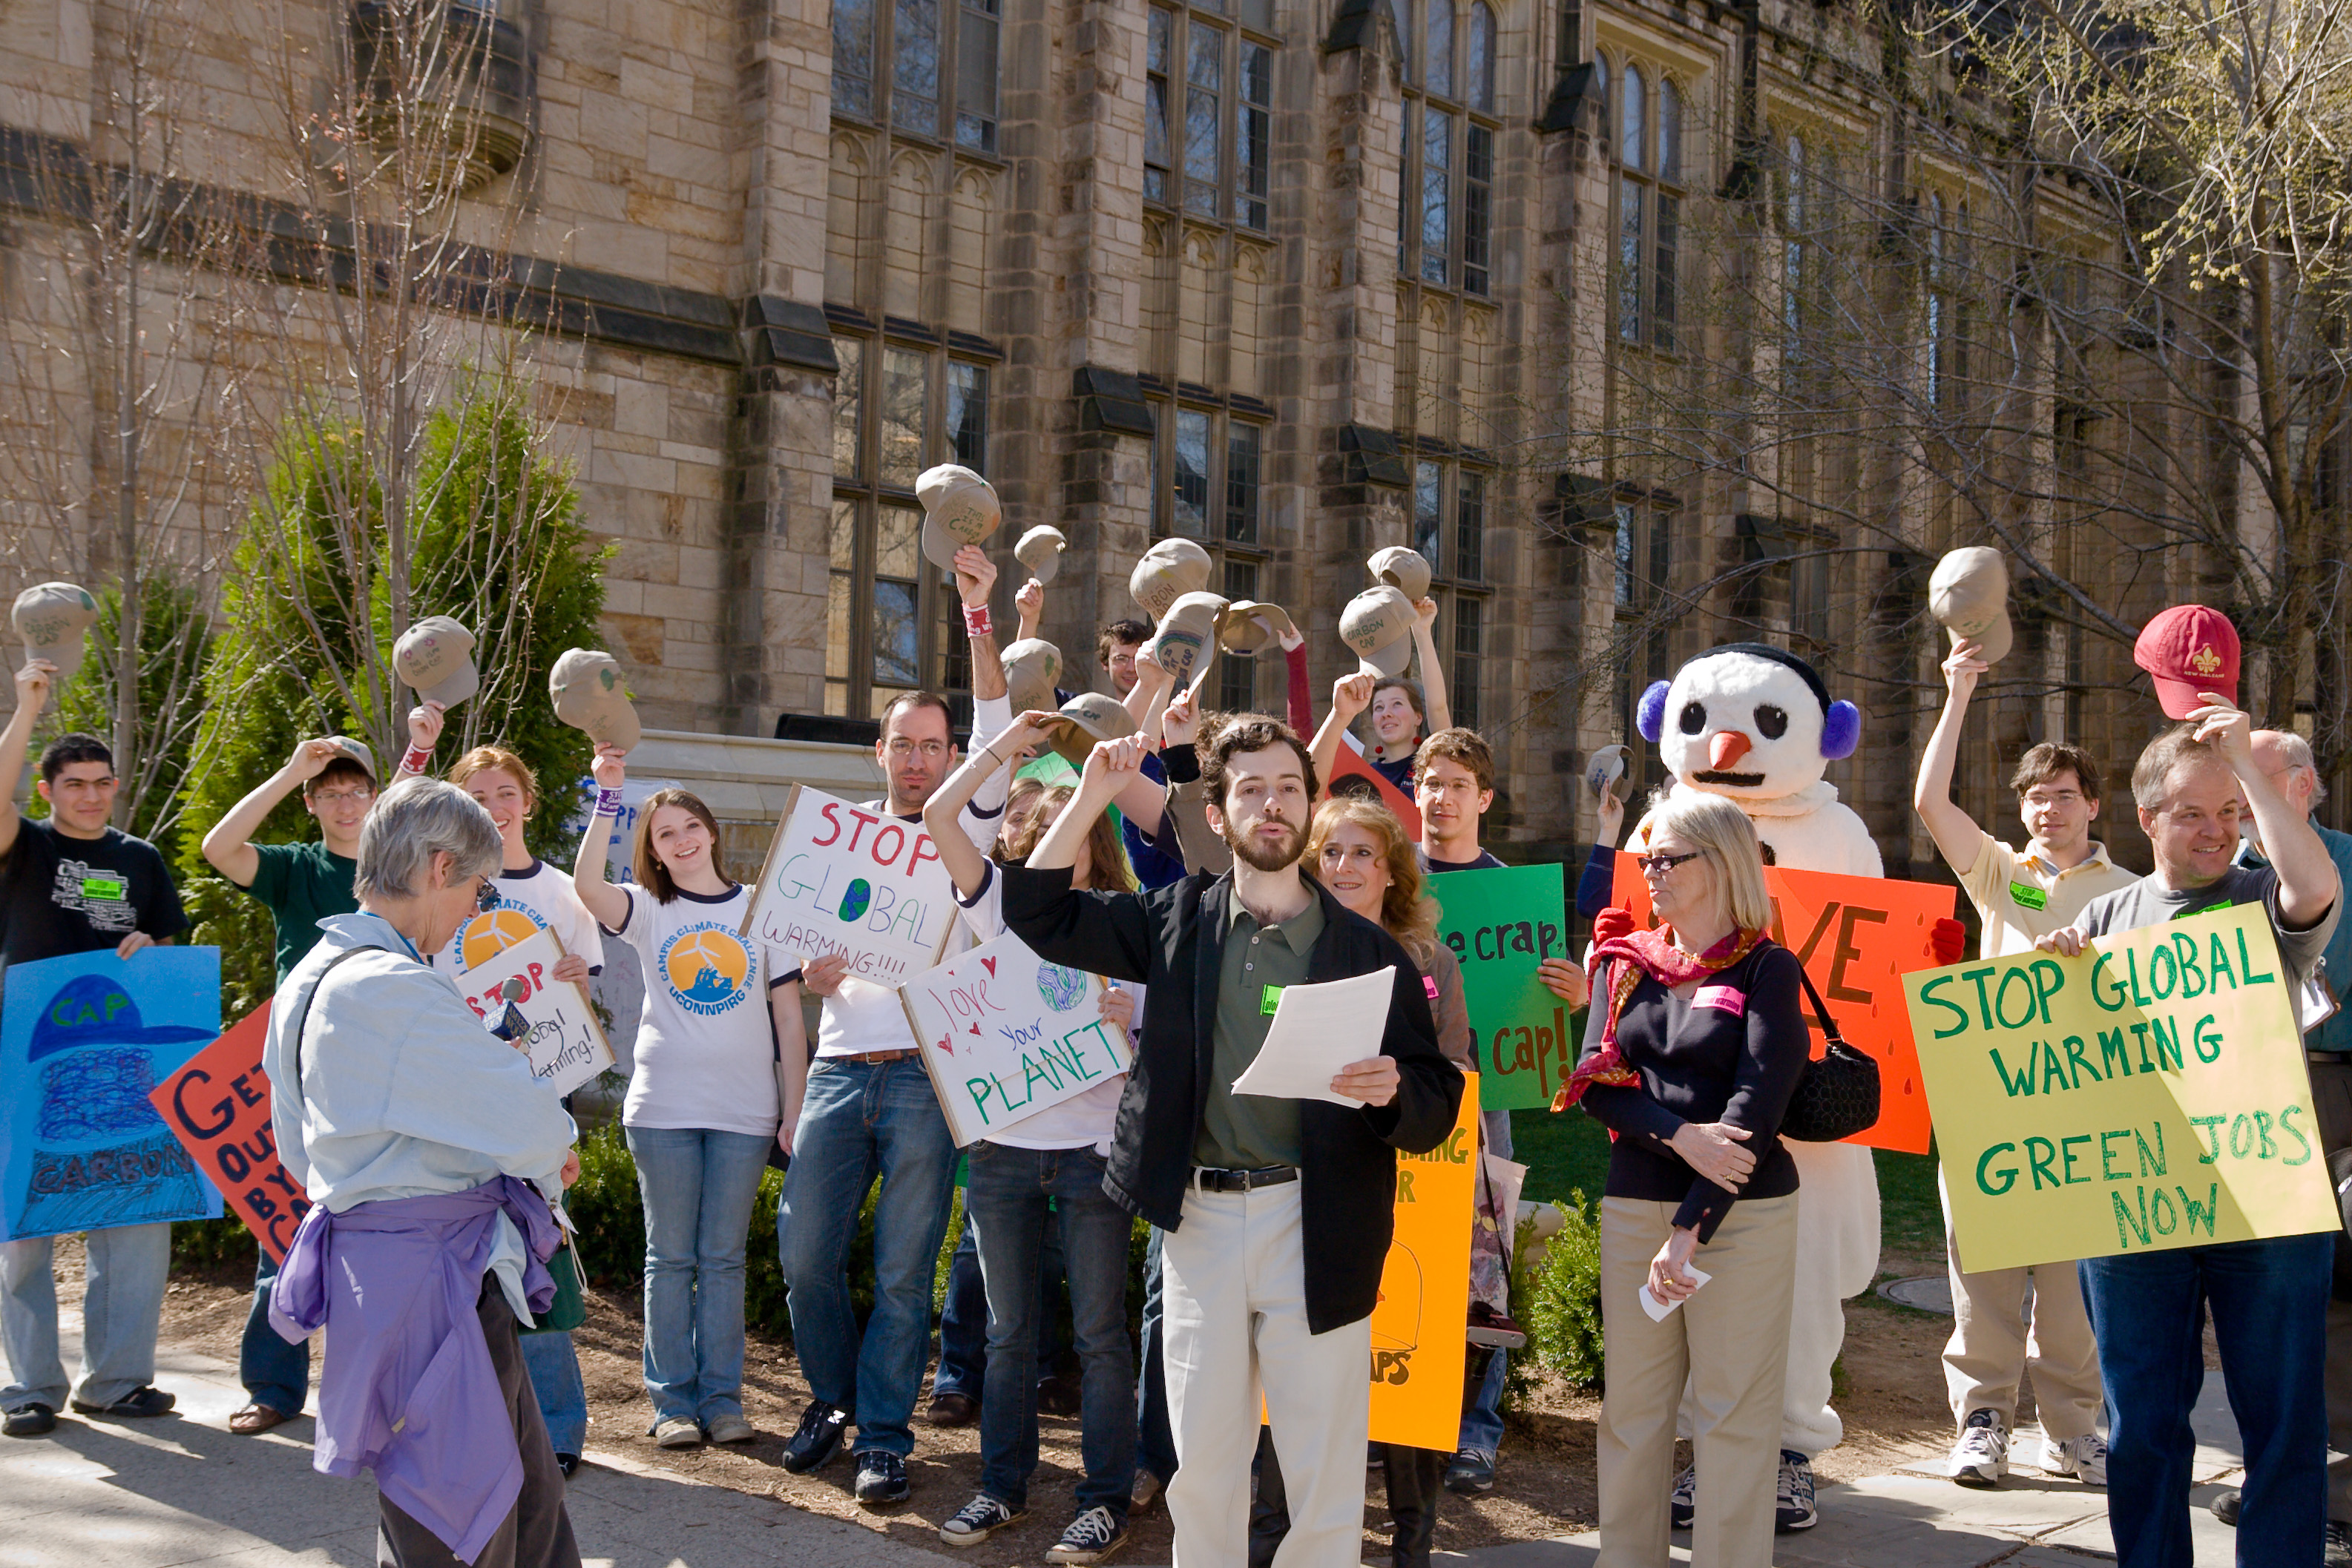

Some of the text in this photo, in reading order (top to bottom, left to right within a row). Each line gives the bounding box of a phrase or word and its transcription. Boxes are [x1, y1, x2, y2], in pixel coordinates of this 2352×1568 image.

[1347, 619, 1384, 641] CARBON
[1359, 636, 1375, 649] CAP
[812, 803, 940, 877] STOP
[778, 854, 932, 949] GLOBAL
[658, 921, 757, 990] CAMPUS CLIMATE CHALLENGE
[1475, 921, 1563, 965] crap,
[52, 993, 129, 1027] CAP
[669, 986, 746, 1015] UCONNPIRG
[1715, 998, 1740, 1012] warming
[1920, 928, 2275, 1039] STOP GLOBAL
[527, 1008, 566, 1049] obal
[530, 1024, 595, 1078] arming!
[1989, 1013, 2224, 1097] WARMING
[966, 1018, 1120, 1125] PLANET
[32, 1144, 194, 1193] CARBON
[1976, 1104, 2312, 1196] GREEN JOBS
[243, 1164, 296, 1221] BY
[2112, 1182, 2218, 1248] NOW
